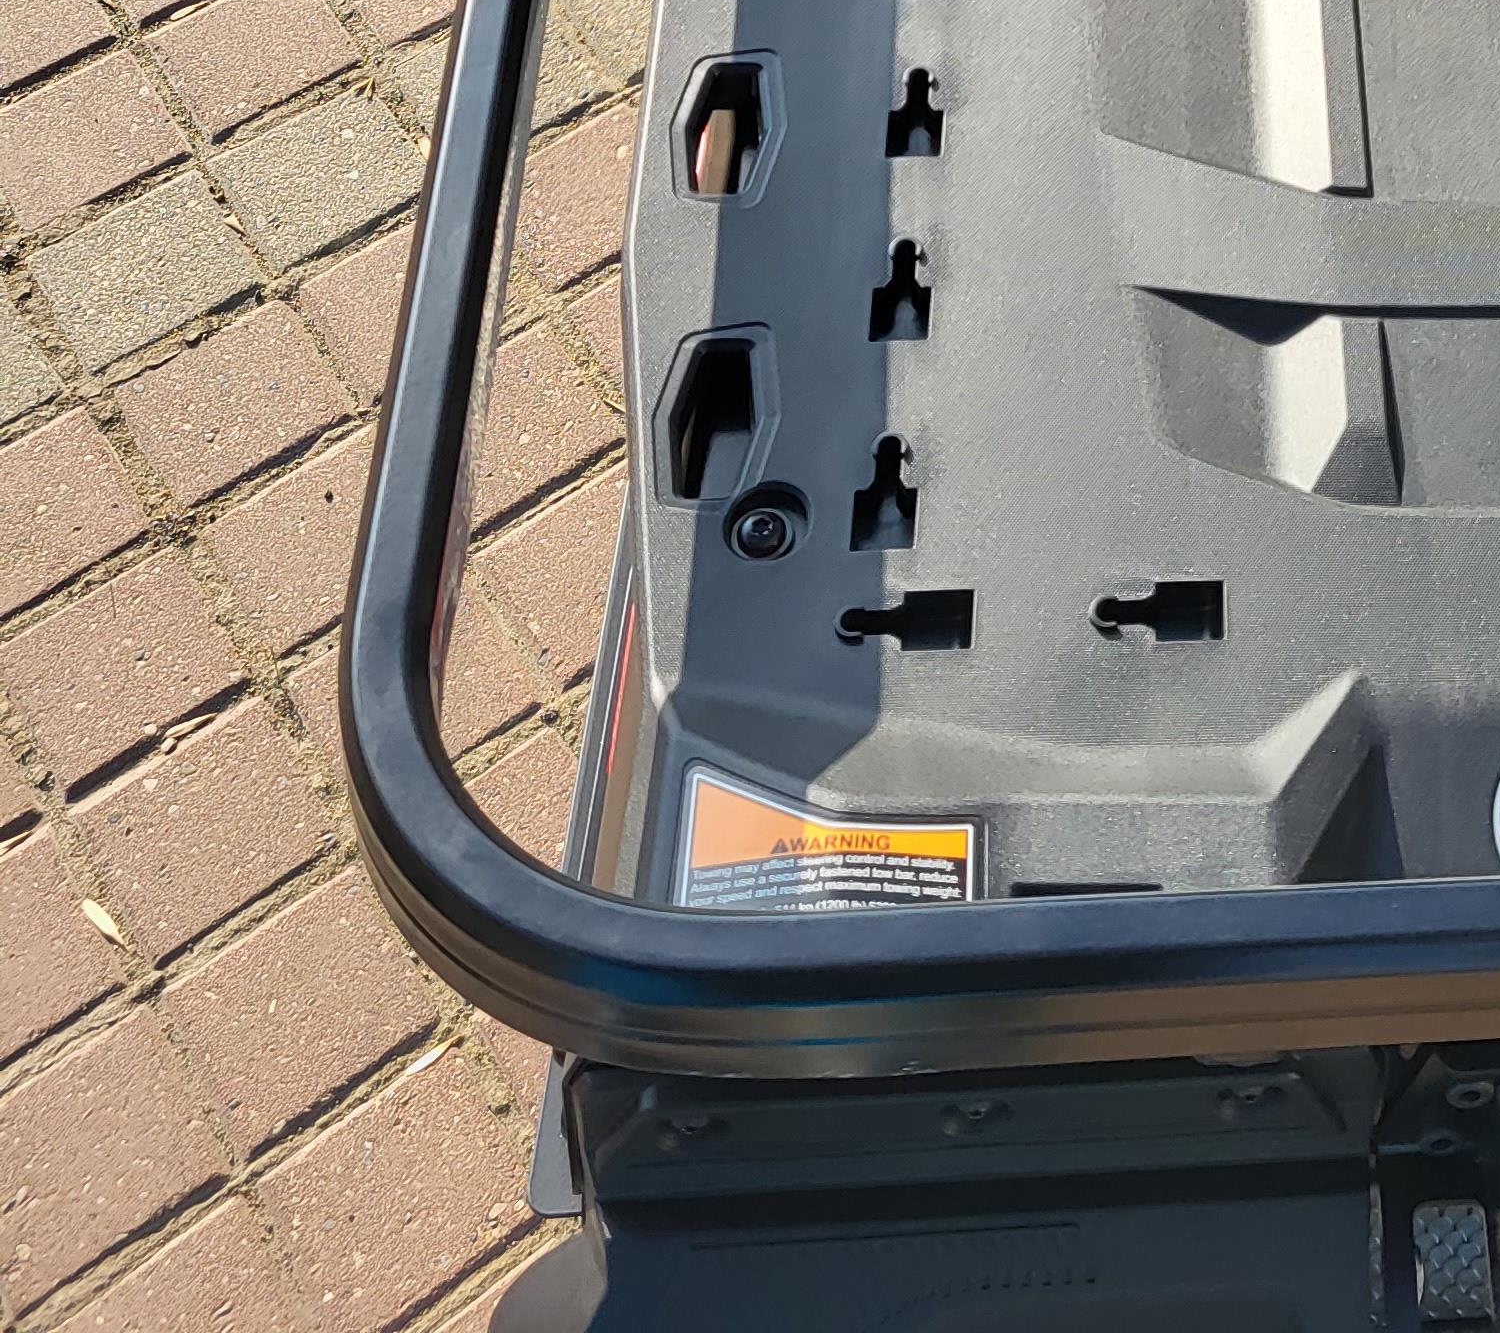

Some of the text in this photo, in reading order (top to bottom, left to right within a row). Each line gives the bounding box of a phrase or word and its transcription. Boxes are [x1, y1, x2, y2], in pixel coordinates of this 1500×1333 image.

[790, 834, 890, 852] WARNING
[690, 880, 732, 893] Always
[733, 877, 756, 888] use
[757, 876, 767, 885] a
[768, 868, 818, 883] securely
[819, 866, 870, 878] fastened
[919, 871, 959, 883] reduce
[693, 854, 956, 880] Towing may affect steering control and stability.
[688, 880, 963, 907] your speed and respect maximum towing weight.
